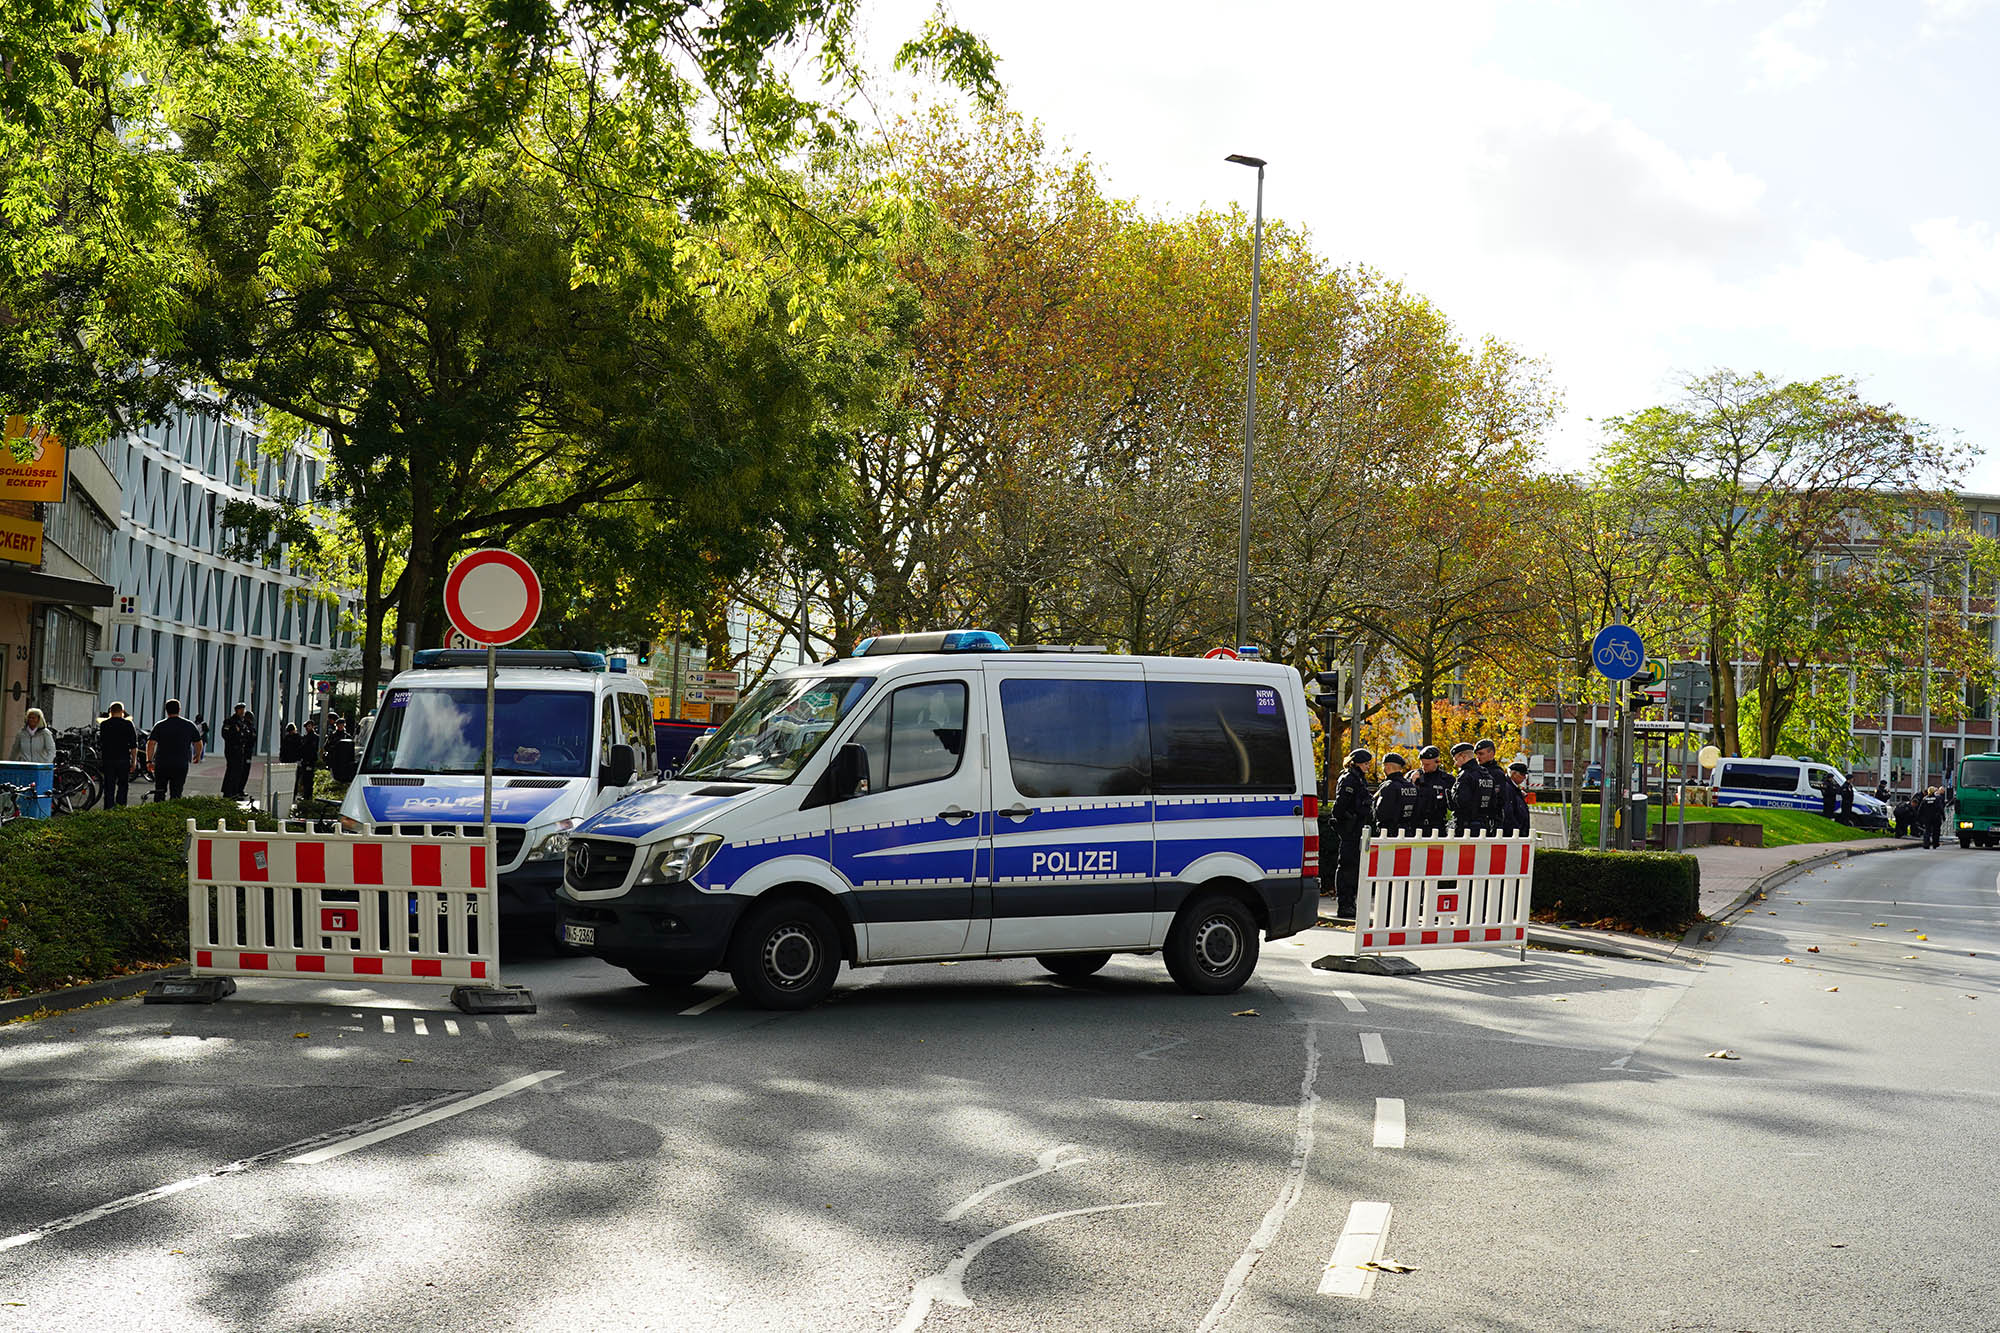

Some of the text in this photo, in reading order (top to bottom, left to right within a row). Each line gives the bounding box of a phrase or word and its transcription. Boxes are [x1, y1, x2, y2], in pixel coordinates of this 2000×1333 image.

[0, 467, 58, 478] SCHLÜSSEL
[6, 478, 48, 488] ECKERT
[16, 645, 28, 661] 33
[1256, 690, 1274, 698] NRW
[1258, 698, 1275, 706] 2613
[402, 797, 510, 810] POLIZEI
[1032, 850, 1118, 873] POLIZEI
